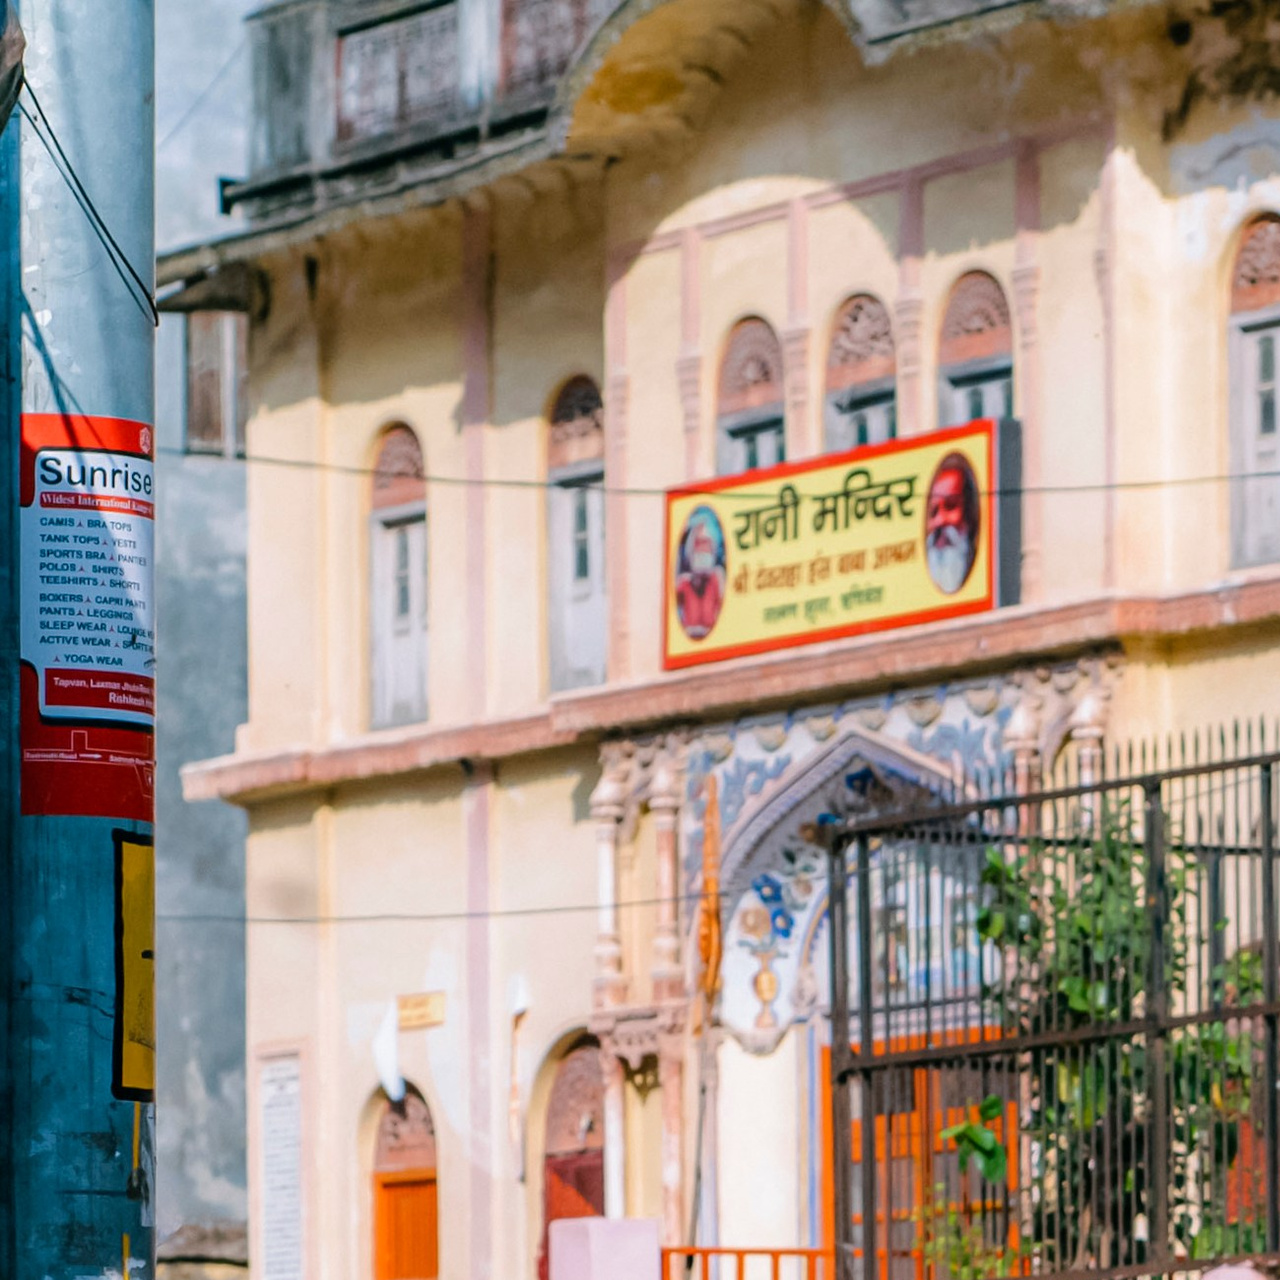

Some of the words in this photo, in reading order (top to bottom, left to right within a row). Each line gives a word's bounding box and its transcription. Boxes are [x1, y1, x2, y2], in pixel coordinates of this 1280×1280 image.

[40, 457, 152, 495] Sunrise
[732, 483, 800, 551] रानी
[812, 468, 917, 532] मन्दिर
[40, 517, 75, 527] CAMIS
[87, 519, 107, 529] BRA
[109, 521, 132, 532] TOPS
[39, 533, 70, 543] TANK
[72, 535, 100, 545] TOPS
[39, 549, 83, 559] SPORTS
[85, 550, 107, 560] BRA
[39, 562, 76, 572] POLOS
[91, 564, 125, 576] SHIRTS
[39, 575, 98, 586] TEESHIRTS
[109, 579, 140, 591] SHORTS
[39, 593, 83, 602] BOXERS
[94, 595, 123, 606] CAPRI
[39, 606, 75, 616] PANTS
[86, 608, 134, 621] LEGGINGS
[39, 620, 75, 630] SLEEP
[76, 622, 107, 632] WEAR
[39, 635, 79, 645] ACTIVE
[81, 637, 111, 647] WEAR
[64, 653, 94, 664] YOGA
[95, 655, 123, 666] WEAR
